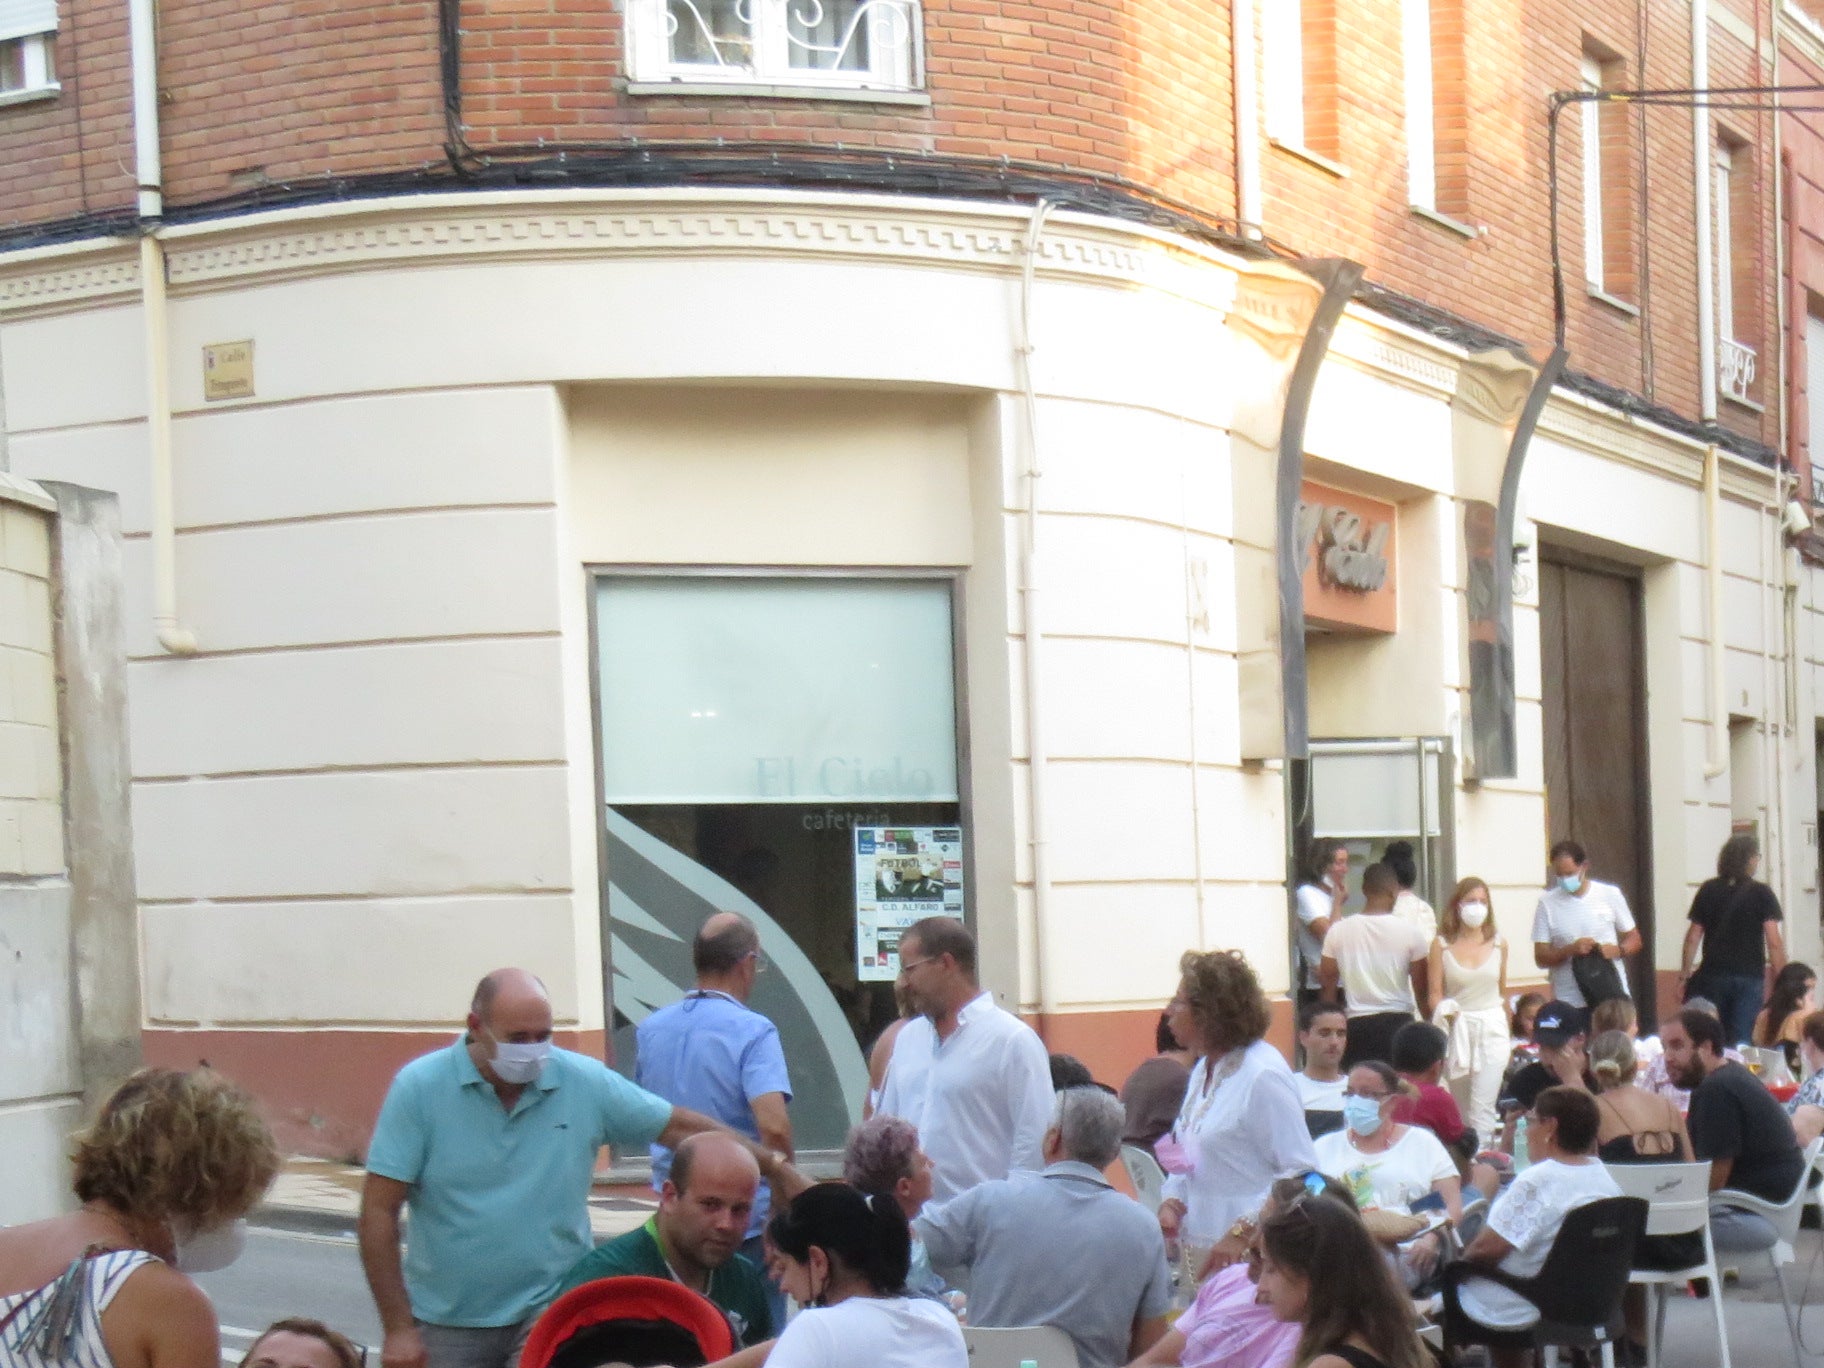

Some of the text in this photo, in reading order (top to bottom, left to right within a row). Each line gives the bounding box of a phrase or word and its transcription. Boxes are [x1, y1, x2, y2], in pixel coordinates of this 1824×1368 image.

[755, 756, 935, 797] El Cielo
[902, 903, 939, 911] ALFARO
